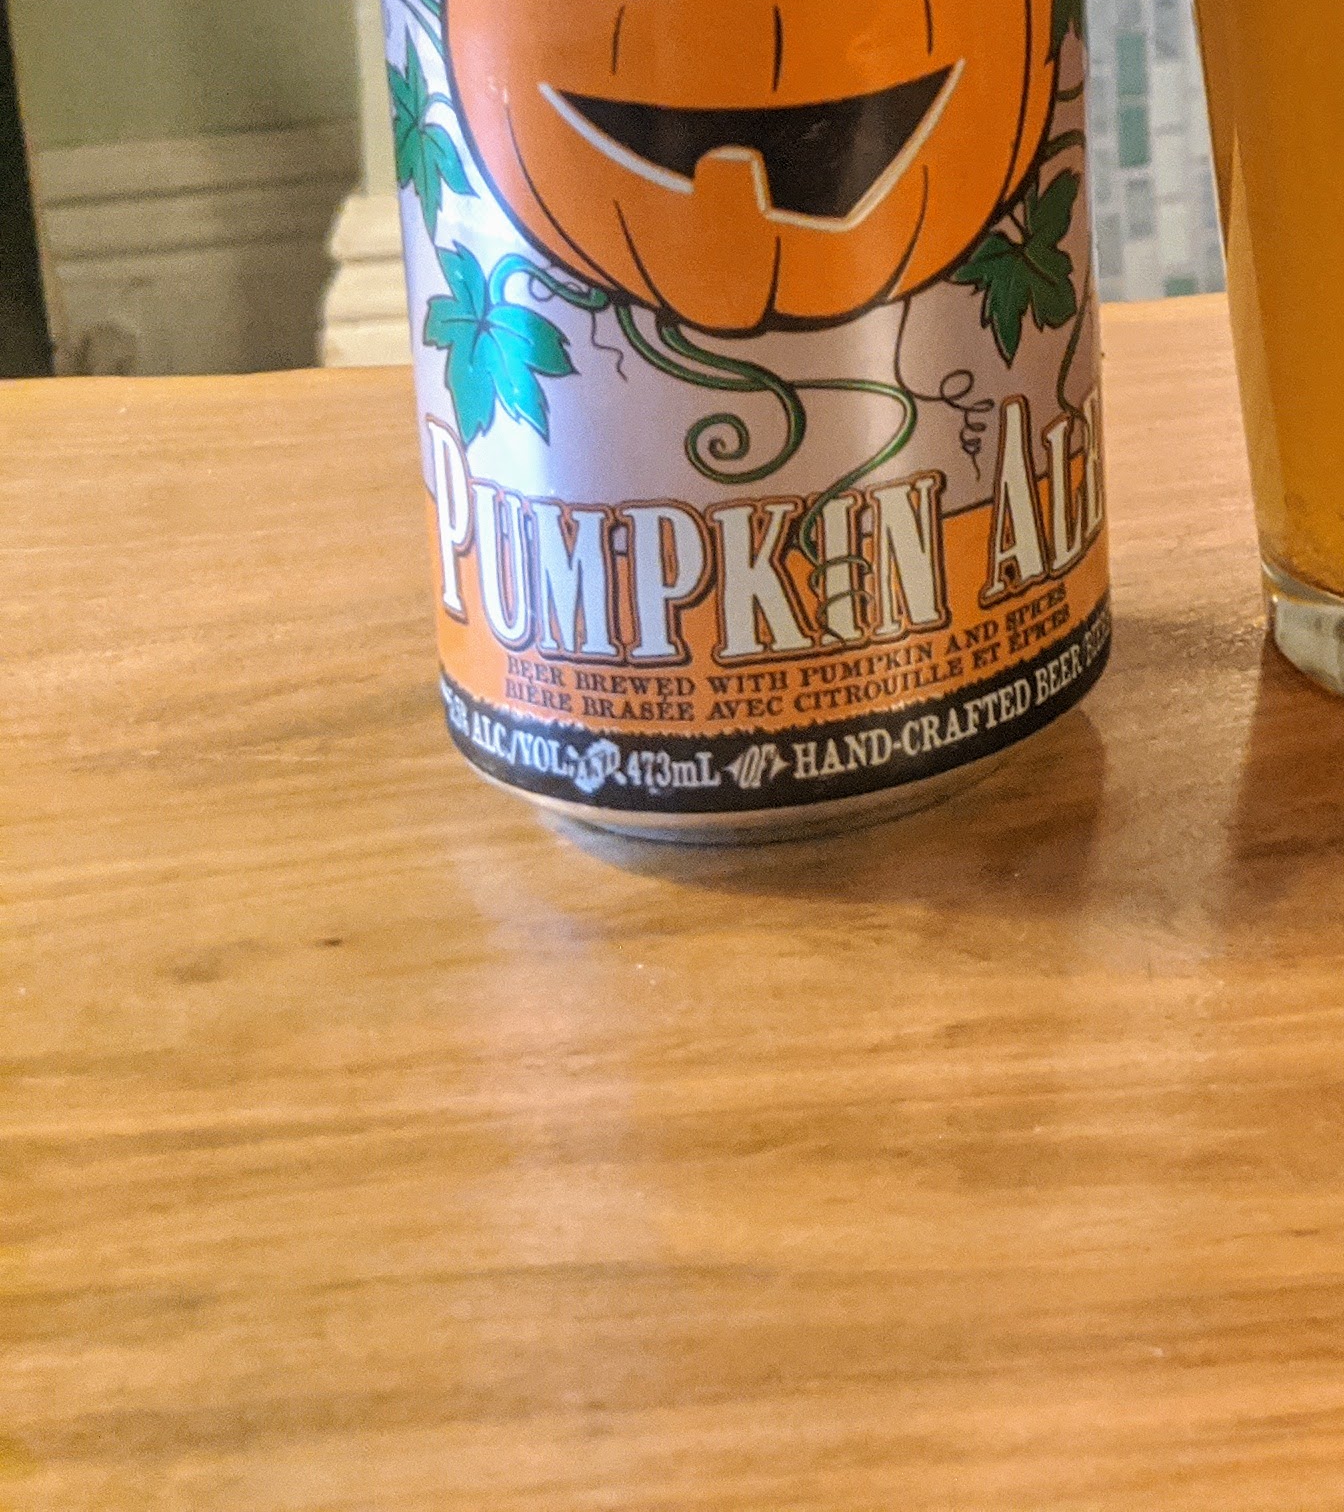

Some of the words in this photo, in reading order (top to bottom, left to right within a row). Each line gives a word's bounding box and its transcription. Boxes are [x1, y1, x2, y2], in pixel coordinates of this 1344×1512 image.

[427, 414, 948, 666] PUMPKIN
[508, 654, 565, 687] BEER
[575, 670, 696, 697] BREWED
[705, 670, 789, 696] WITH
[800, 641, 933, 688] PUMPKIN
[947, 619, 999, 657] AND
[706, 696, 785, 721] AVEC
[793, 656, 964, 713] CITROUILLE
[972, 641, 1001, 670] ET
[792, 677, 1032, 780] HAND-CRAFTED
[1034, 642, 1083, 706] BEER
